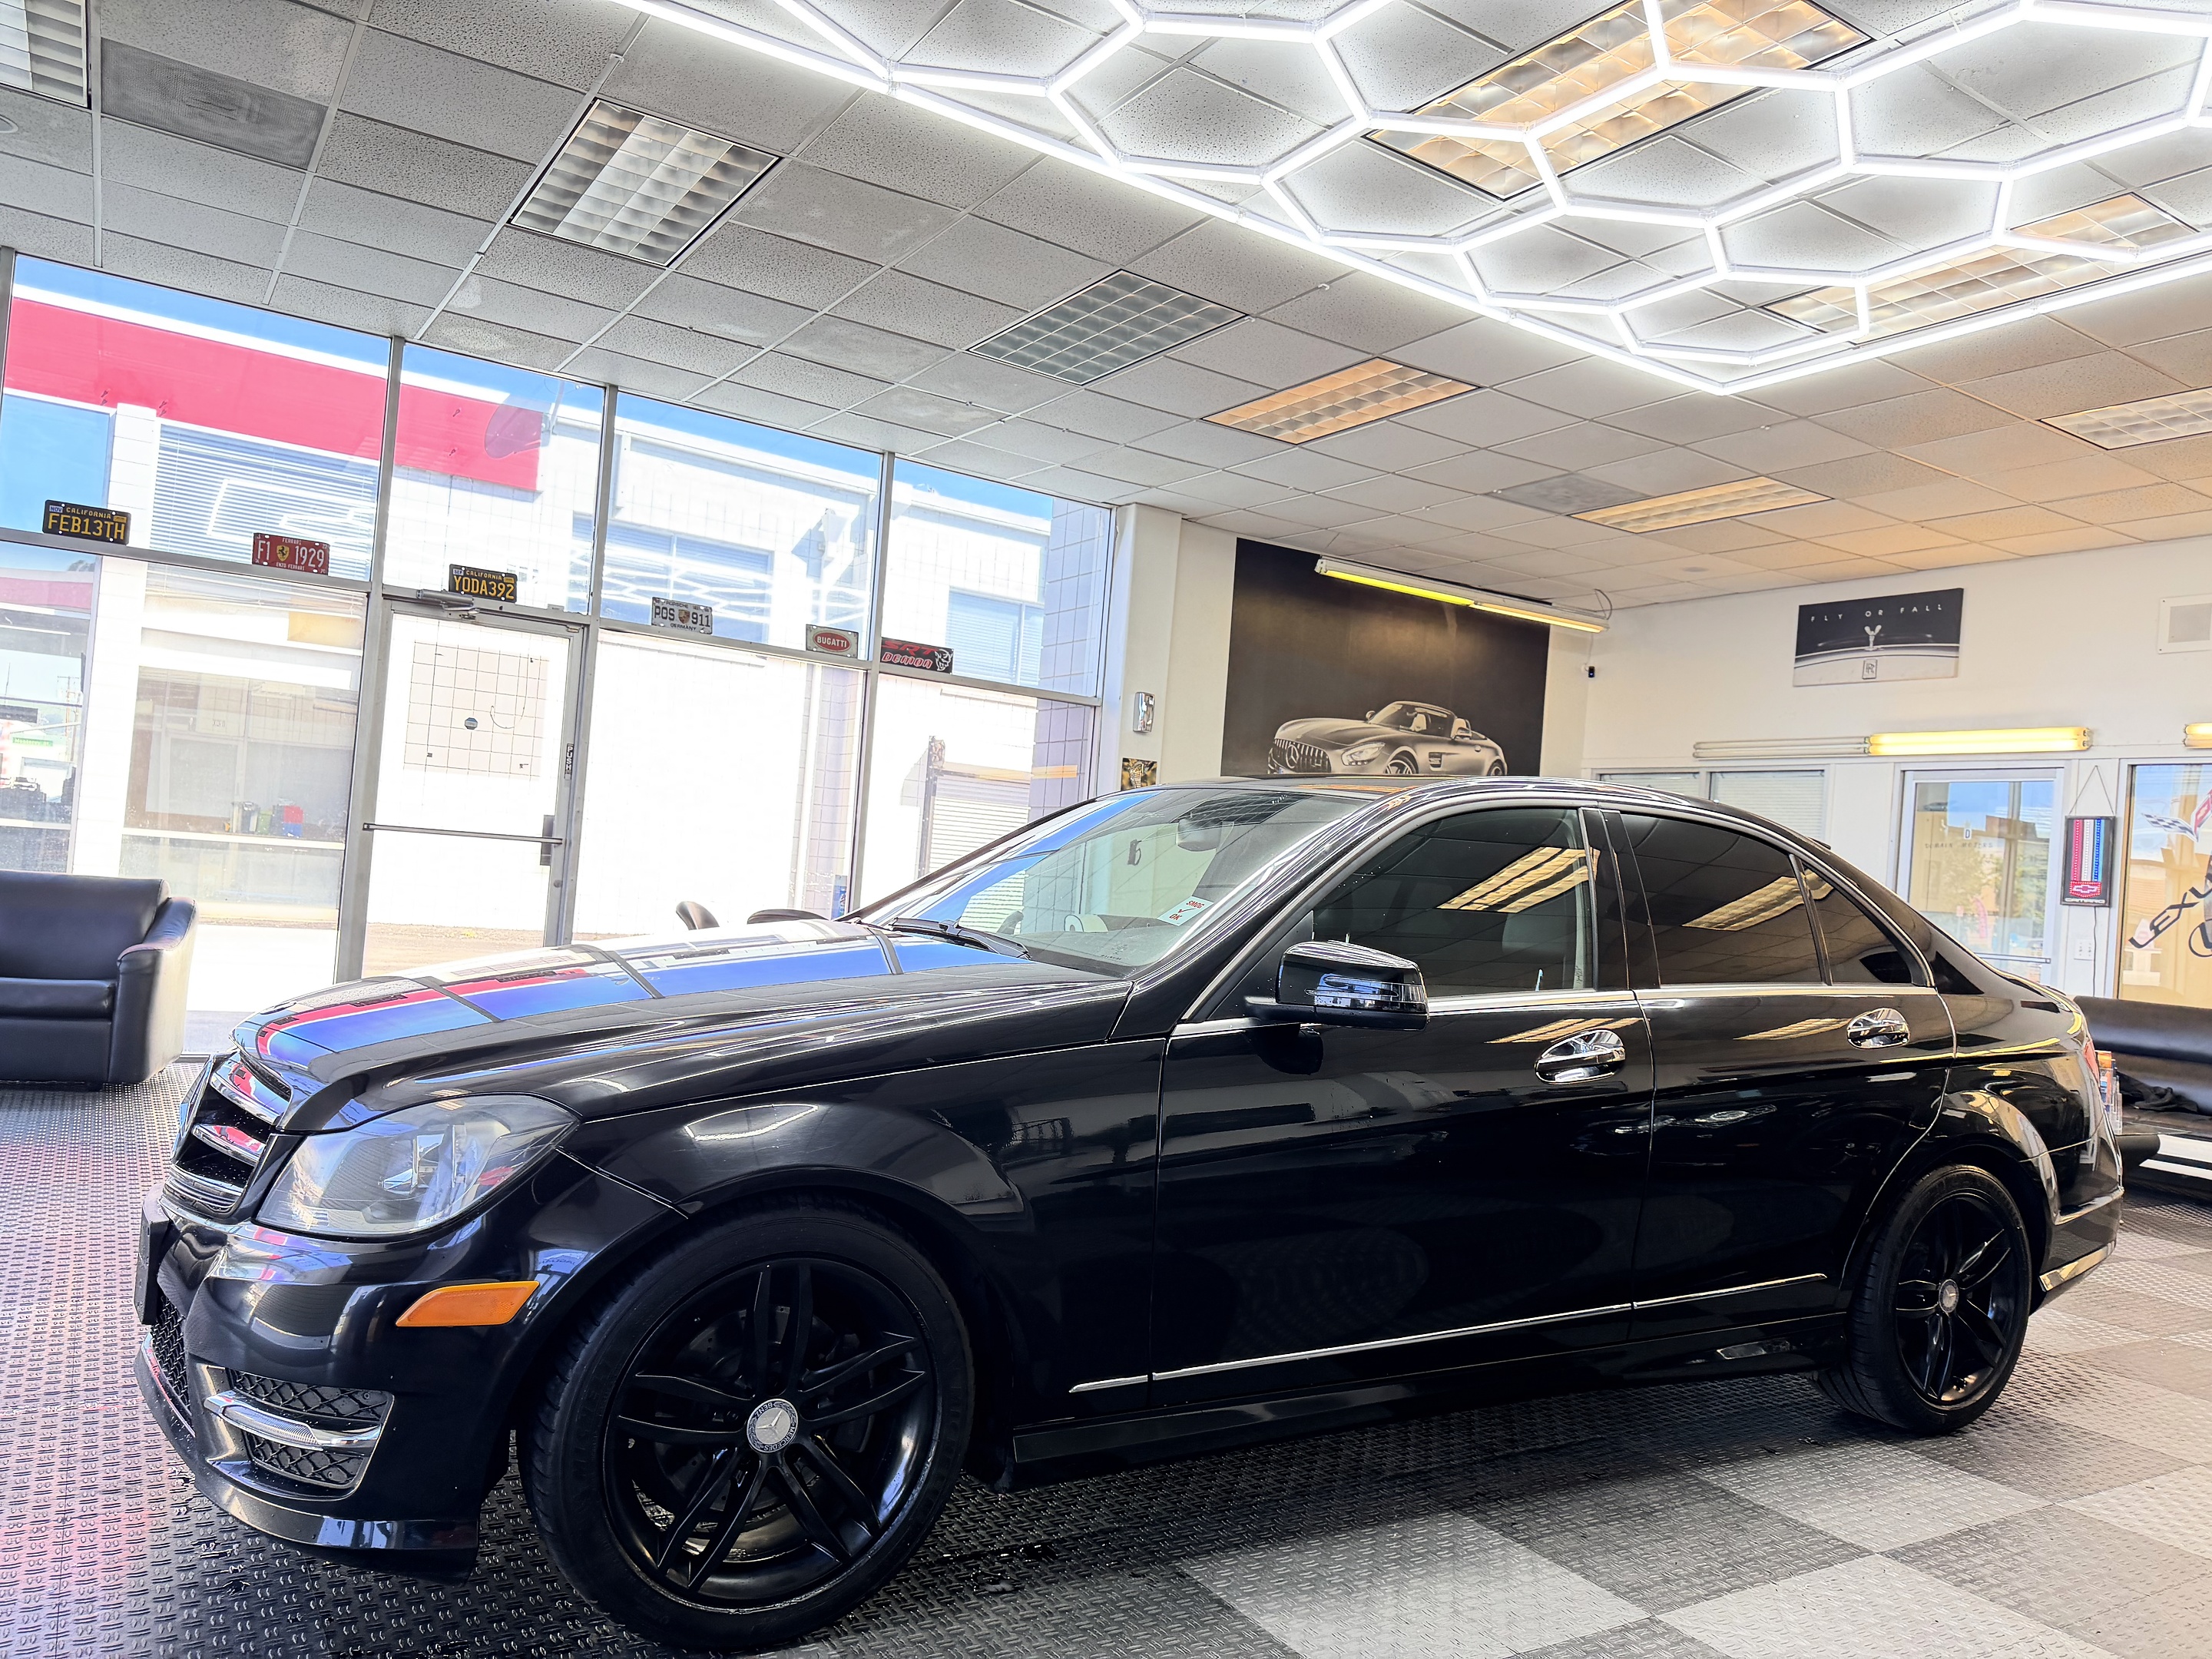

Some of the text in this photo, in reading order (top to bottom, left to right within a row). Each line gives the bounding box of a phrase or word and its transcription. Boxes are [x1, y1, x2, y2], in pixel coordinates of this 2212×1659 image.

[66, 507, 111, 519] CALIFORNIA
[48, 513, 125, 540] FEB13TH
[257, 540, 324, 568] F1 1929
[465, 570, 502, 581] CALIFORNIA
[454, 575, 515, 600] YODA392
[654, 605, 710, 628] POS 911
[1811, 604, 1942, 622] FLY OR FALL
[670, 623, 697, 631] GERMANY
[816, 636, 847, 648] BUGATTI
[882, 641, 939, 656] SRT
[882, 652, 932, 669] DEMON
[1186, 900, 1205, 909] SMOG
[754, 1402, 773, 1418] BENZ
[763, 1426, 796, 1451] MERCEDES
